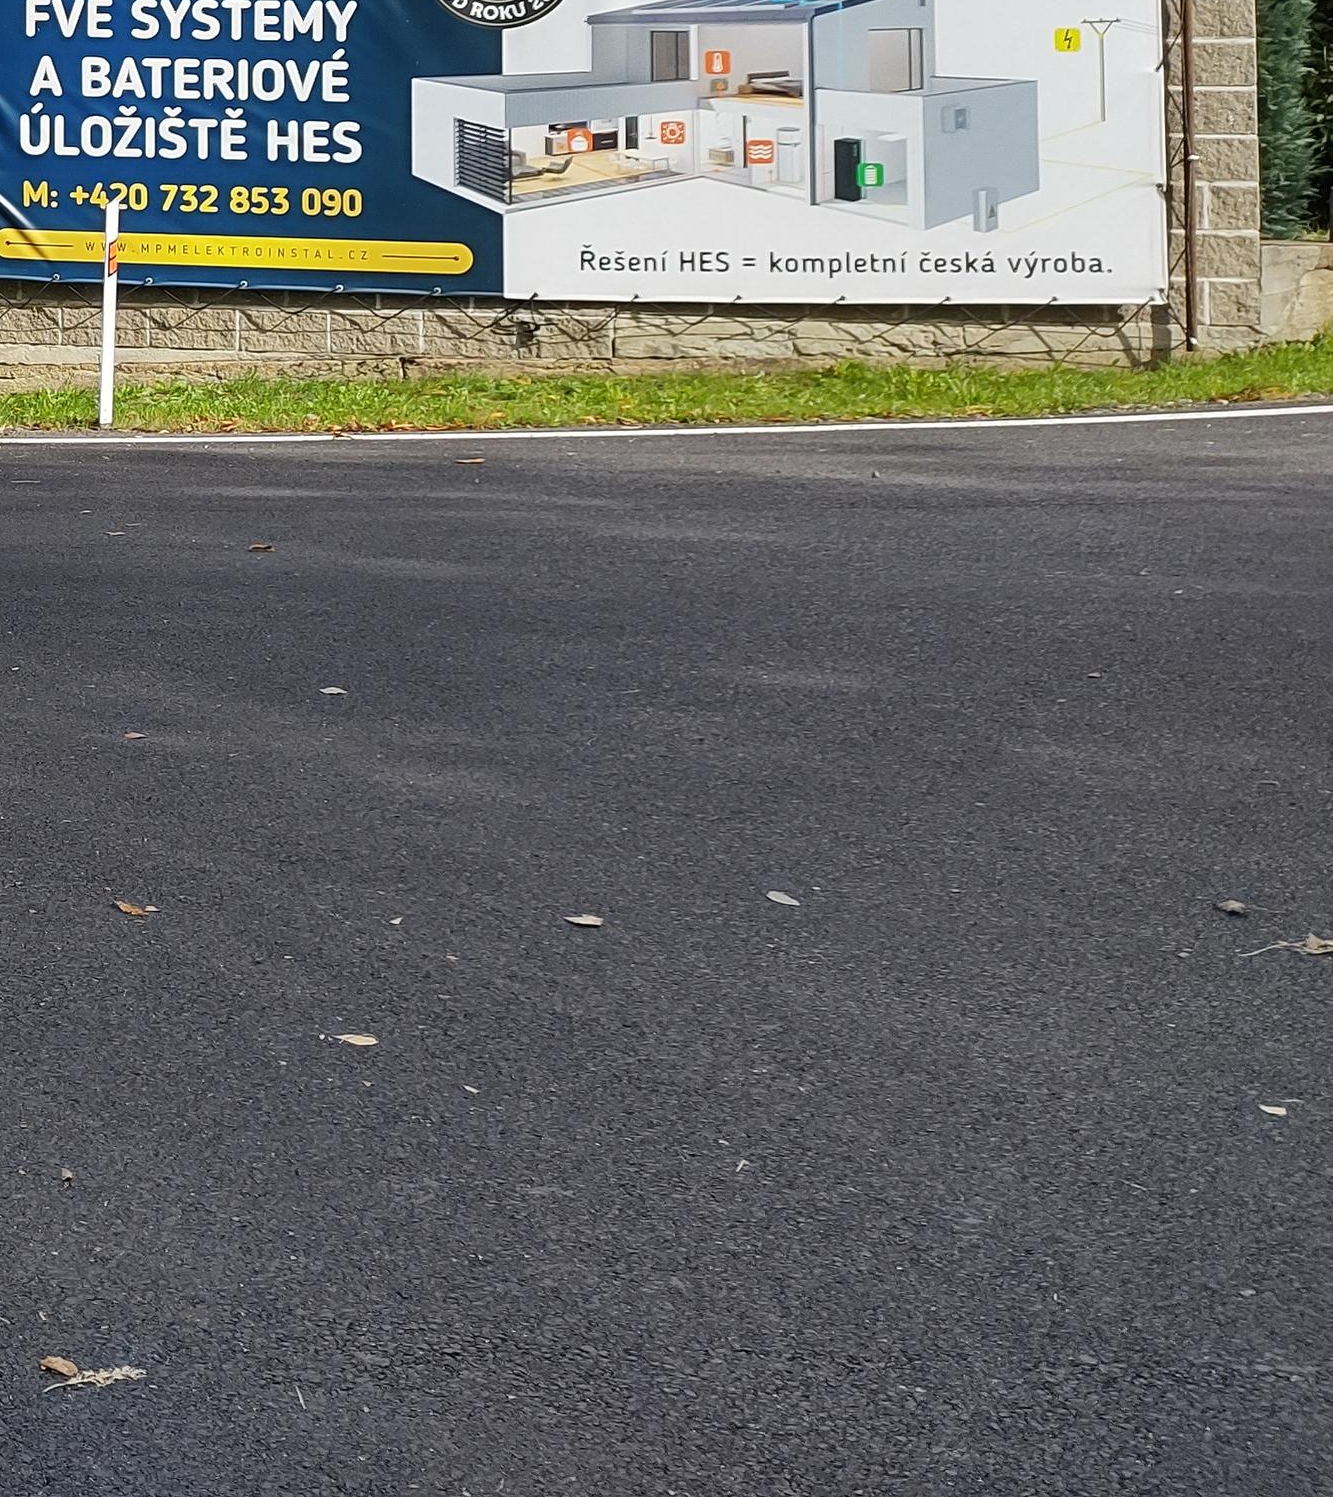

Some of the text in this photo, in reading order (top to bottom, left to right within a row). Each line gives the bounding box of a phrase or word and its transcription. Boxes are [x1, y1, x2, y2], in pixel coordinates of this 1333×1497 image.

[470, 2, 526, 20] ROKU
[29, 49, 350, 102] A BATERIOVÉ
[19, 102, 363, 163] ÚLOŽIŠTĚ HES
[23, 180, 363, 217] M: +420 732 853 090
[579, 244, 1113, 279] Řešení HES = kompletní česká výroba.
